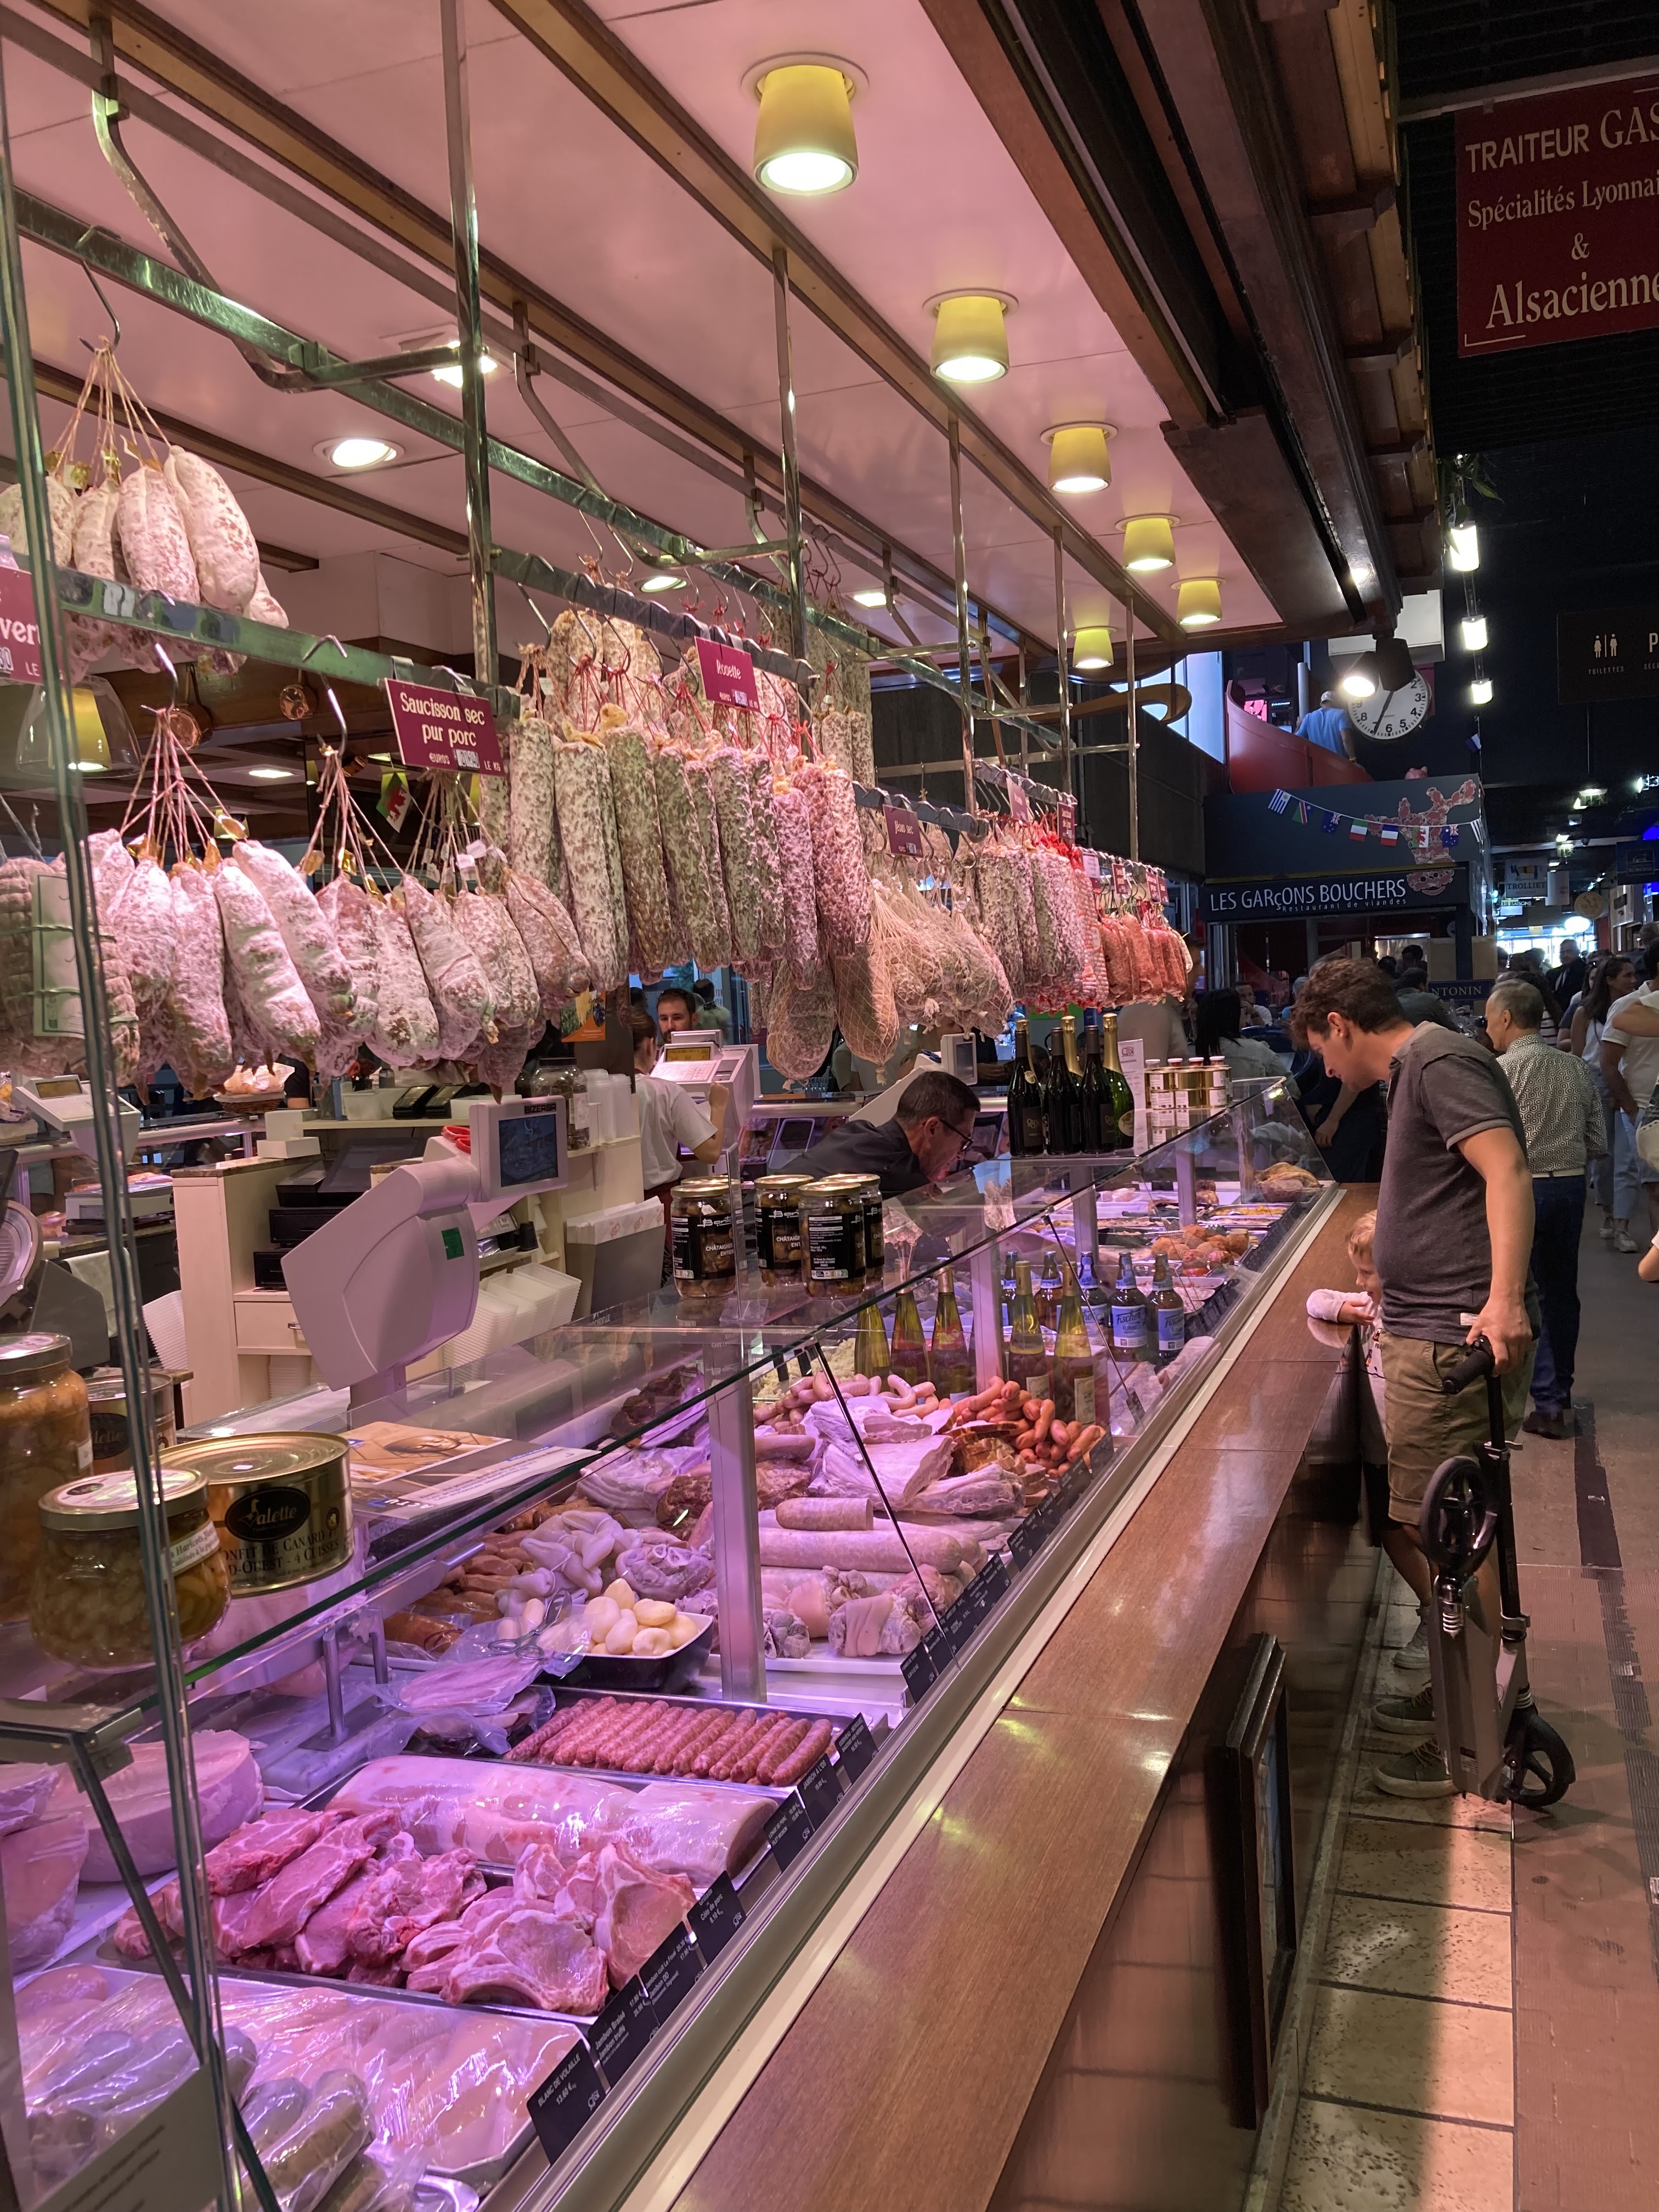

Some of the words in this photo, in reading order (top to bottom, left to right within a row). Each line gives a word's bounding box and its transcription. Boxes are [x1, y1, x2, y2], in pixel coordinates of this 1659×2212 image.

[1465, 123, 1589, 172] TRAITEUR
[1469, 185, 1574, 230] Spécialités
[1571, 233, 1589, 260] &
[25, 661, 41, 677] LE
[716, 659, 741, 680] Rosette
[1588, 666, 1624, 675] TOILETTES
[1410, 680, 1417, 689] 2
[1415, 693, 1421, 702] 3
[400, 692, 461, 721] Saucisson
[464, 708, 485, 725] sec
[1361, 712, 1368, 721] 8
[1410, 707, 1418, 716] 4
[1386, 724, 1392, 733] 6
[1400, 719, 1406, 728] 5
[422, 724, 443, 744] pur
[448, 728, 477, 748] porc
[483, 760, 492, 771] LE
[493, 761, 501, 771] KG
[1210, 891, 1237, 912] LES
[1319, 879, 1406, 902] BOUCHERS
[1506, 882, 1546, 890] TROLLIET
[1283, 903, 1340, 912] Restaurant
[1347, 900, 1358, 909] de
[1365, 898, 1406, 906] viandes
[524, 1103, 556, 1114] BIZERBA
[706, 1243, 733, 1251] CHÂTAIGNES
[283, 1532, 325, 1551] CANARD
[294, 1554, 300, 1564] 4
[304, 1541, 338, 1560] CUISSES
[803, 1771, 816, 1790] JAMBON
[699, 1908, 710, 1921] Côte
[708, 1902, 715, 1911] de
[713, 1893, 723, 1906] porc
[648, 1978, 664, 1999] Jambon
[594, 2025, 613, 2050] Jambon
[610, 2010, 627, 2029] Braisé
[597, 2037, 616, 2060] Jambon
[613, 2024, 627, 2041] truffé
[537, 2084, 554, 2107] BLANC
[552, 2078, 560, 2088] DE
[559, 2052, 581, 2080] VOLAILLE
